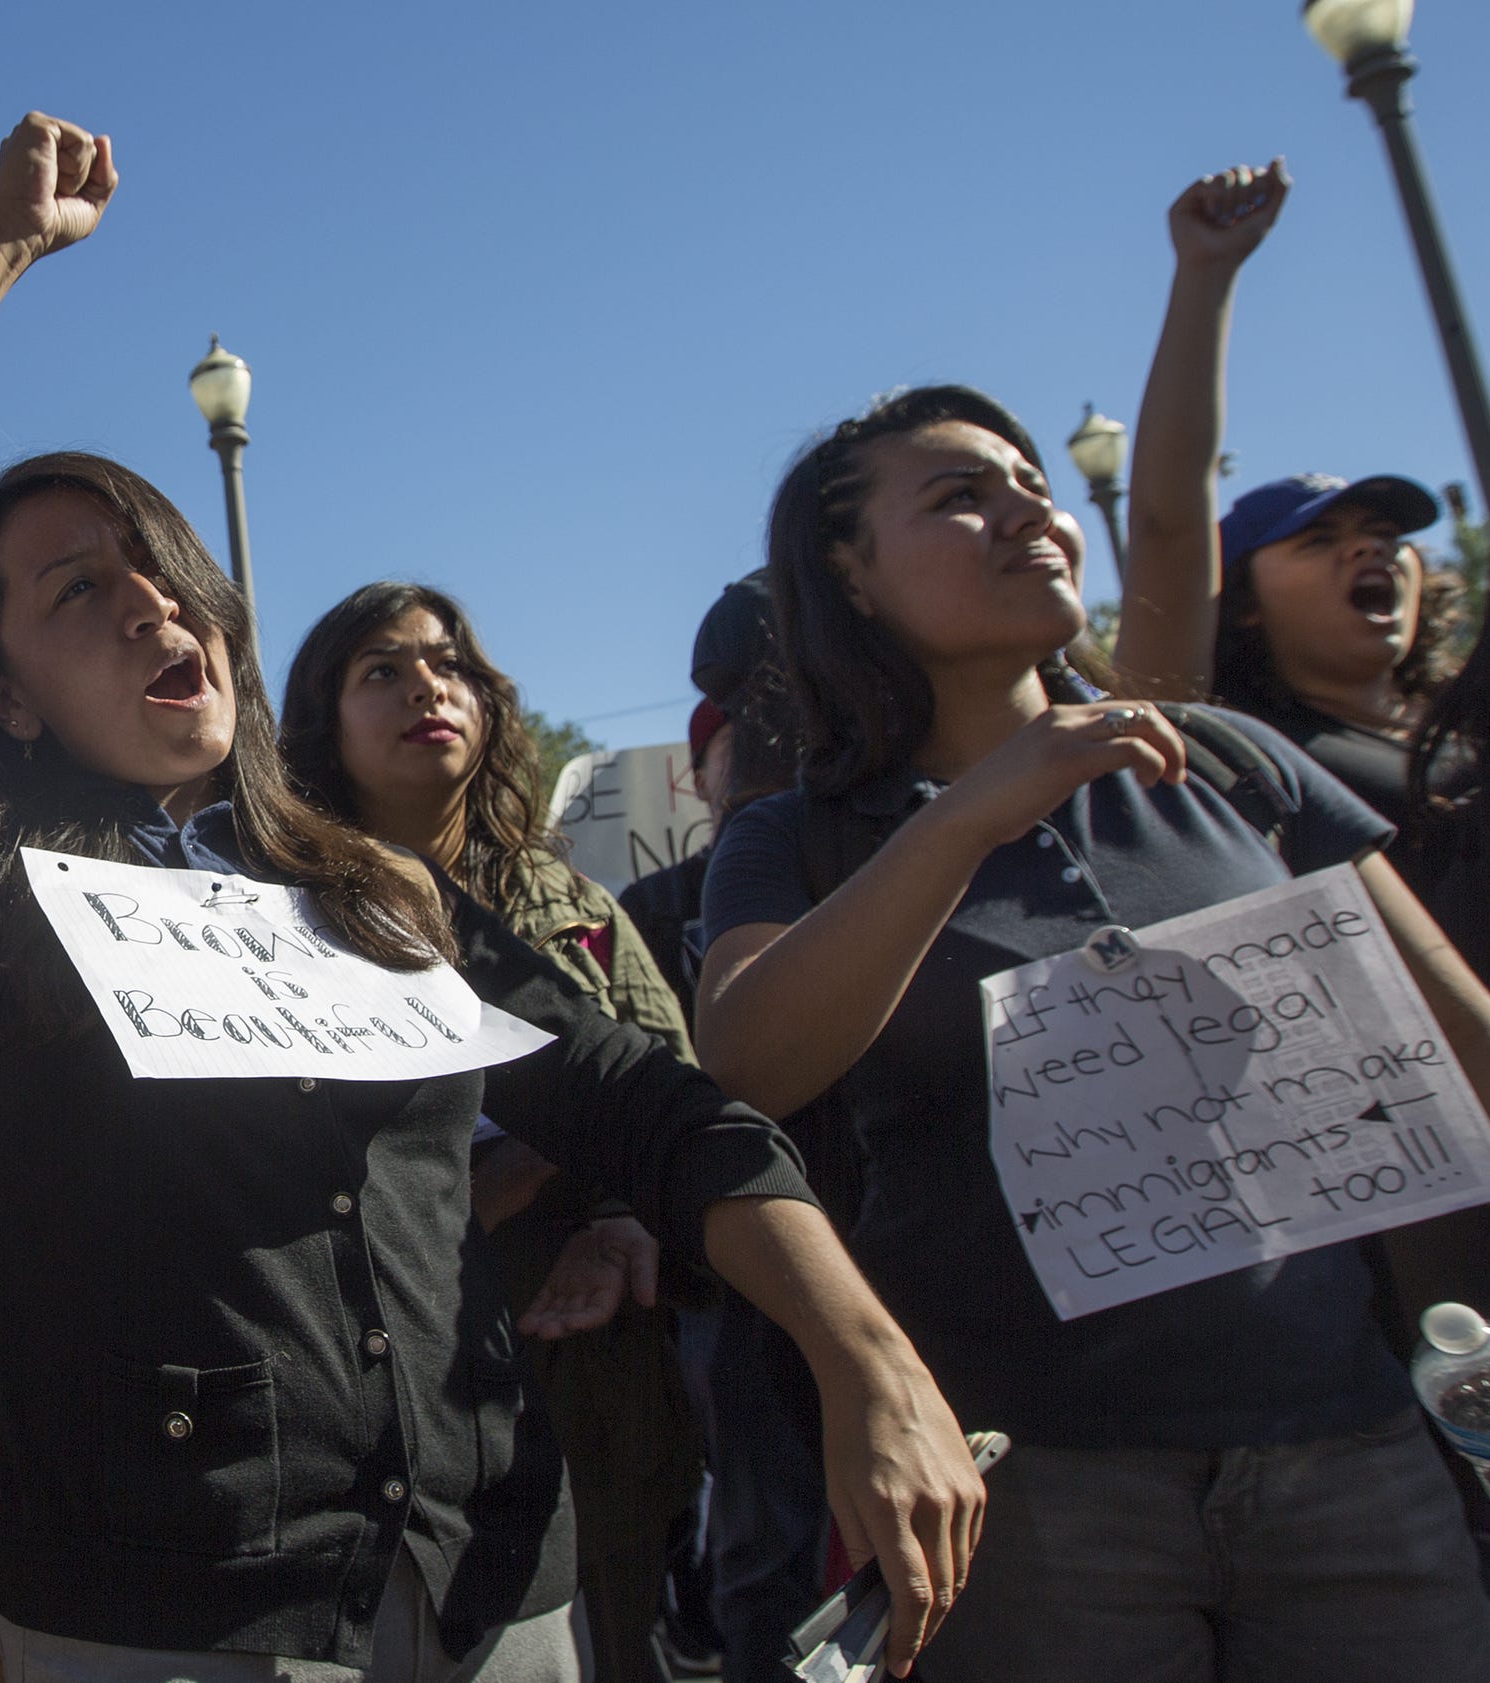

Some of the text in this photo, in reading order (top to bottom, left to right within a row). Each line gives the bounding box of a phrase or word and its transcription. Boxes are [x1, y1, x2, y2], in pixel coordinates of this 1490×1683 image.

[242, 966, 309, 1001] is
[995, 909, 1370, 1047] If they made
[1160, 974, 1338, 1053] legal
[113, 990, 464, 1055] Beautiful
[1144, 1085, 1253, 1132] not
[1263, 1039, 1446, 1104] make
[1039, 1123, 1352, 1230] immigrants
[1066, 1198, 1293, 1279] LEGAL
